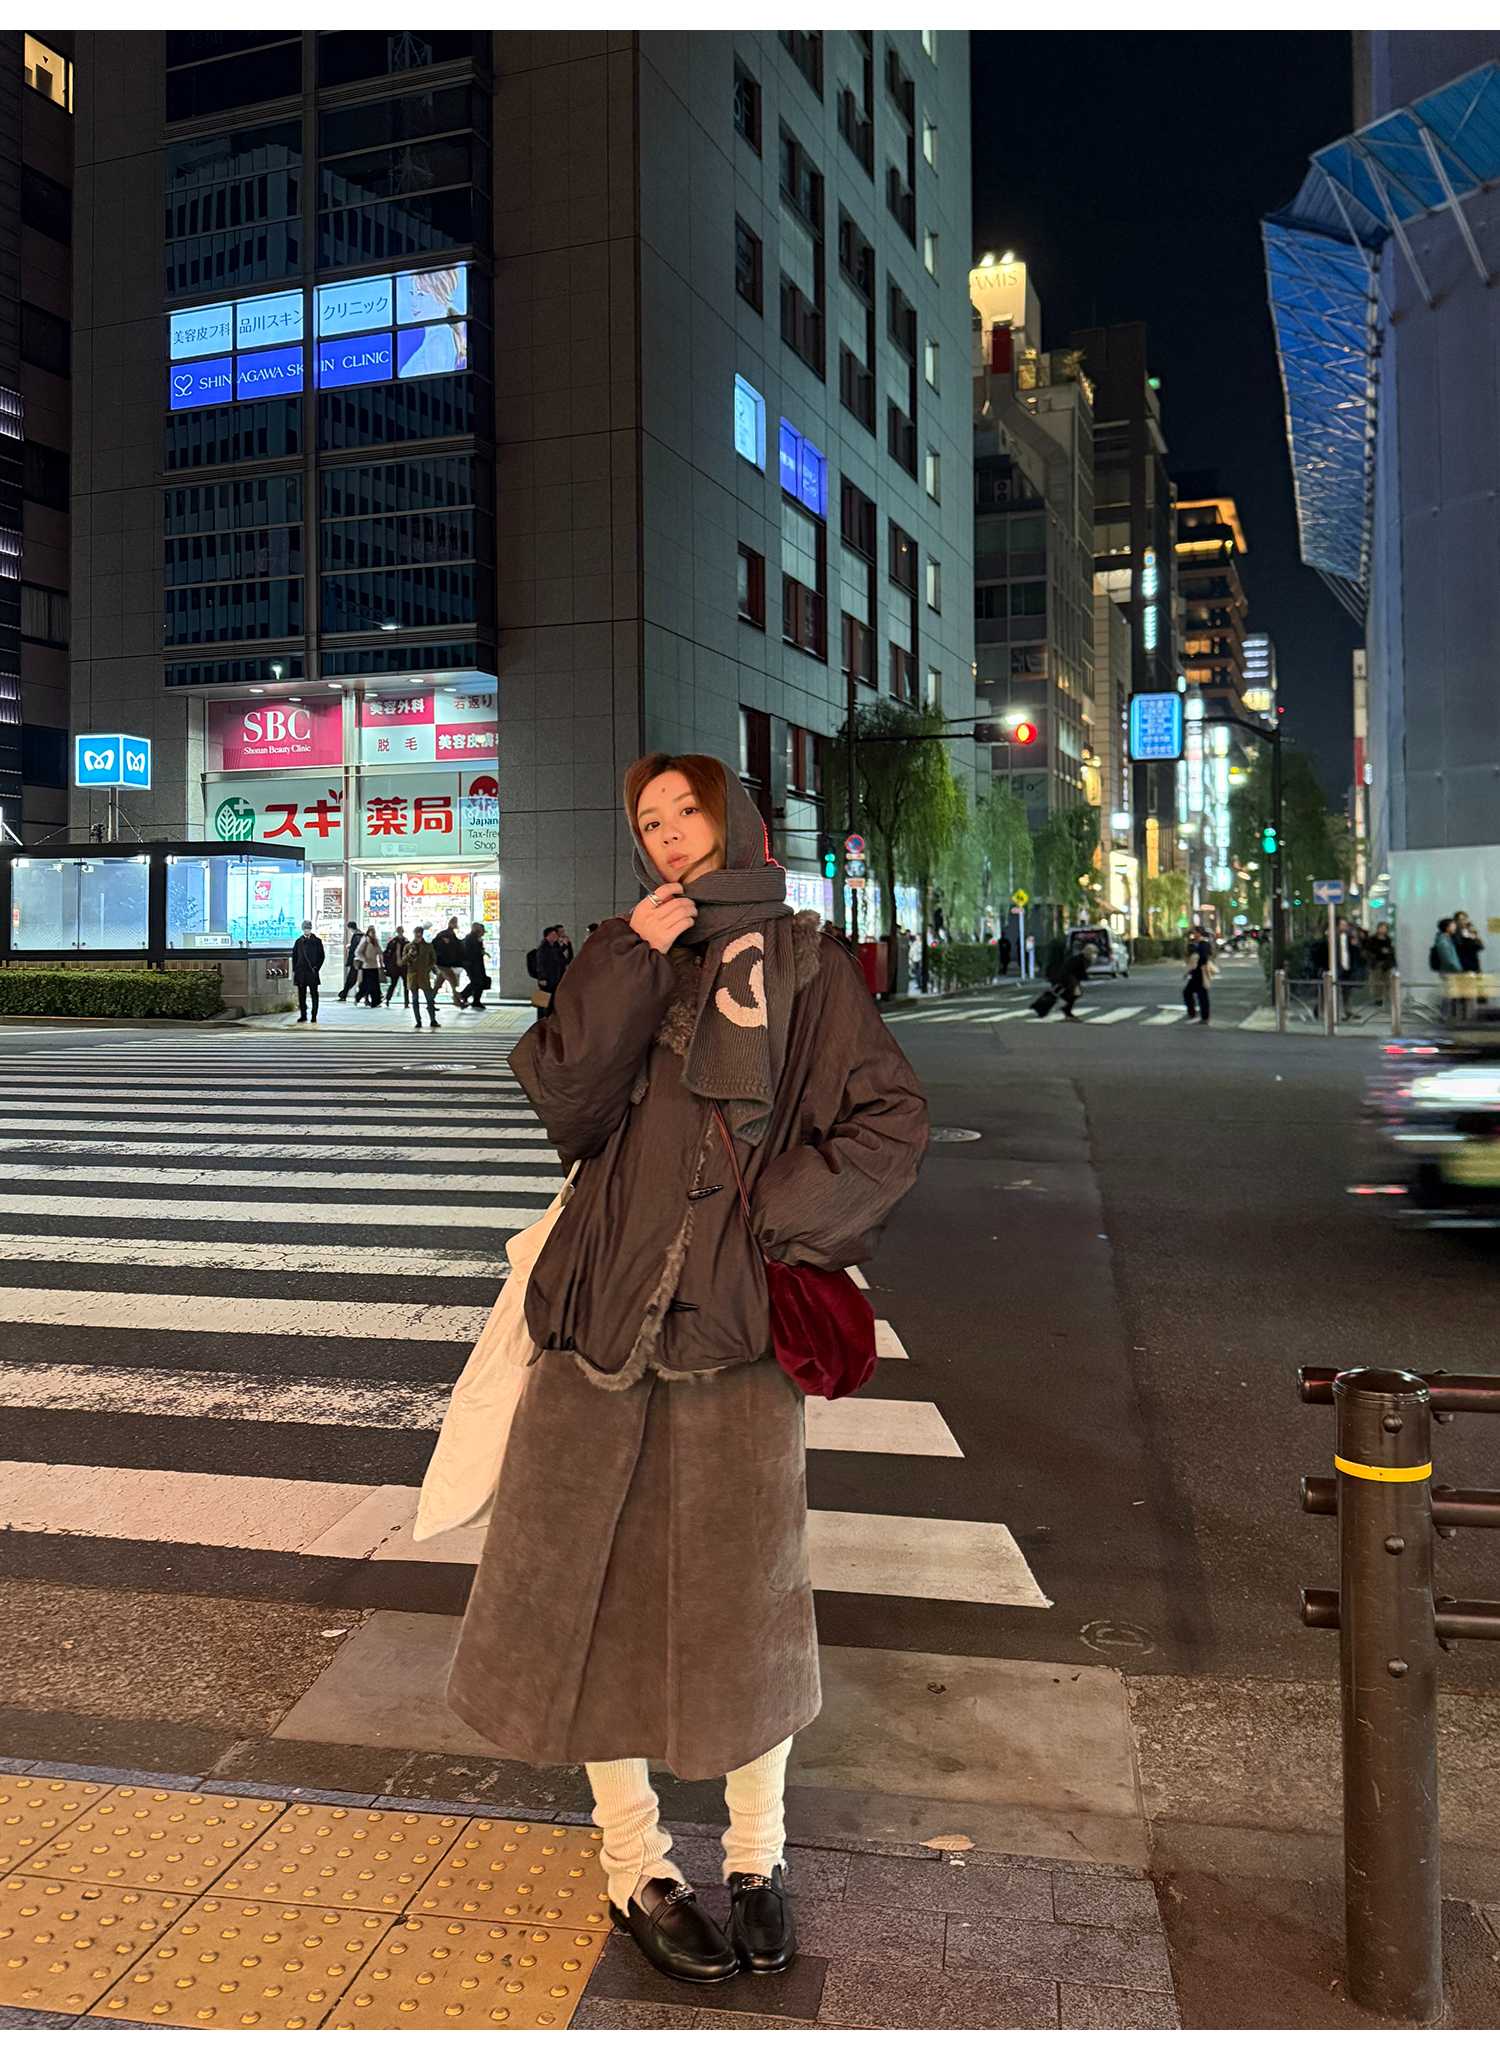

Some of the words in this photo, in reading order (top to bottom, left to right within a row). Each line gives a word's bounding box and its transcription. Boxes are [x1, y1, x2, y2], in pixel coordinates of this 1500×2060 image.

[173, 322, 231, 345] 美容皮フ科
[323, 296, 388, 321] クリニック
[342, 350, 390, 369] CLINIC
[370, 697, 425, 716] 美容外科
[243, 708, 311, 742] SBC
[243, 746, 268, 755] Shonan
[268, 745, 291, 755] Beauty
[290, 744, 312, 753] Clinic
[377, 736, 418, 752] 脱毛
[474, 840, 497, 850] Shop
